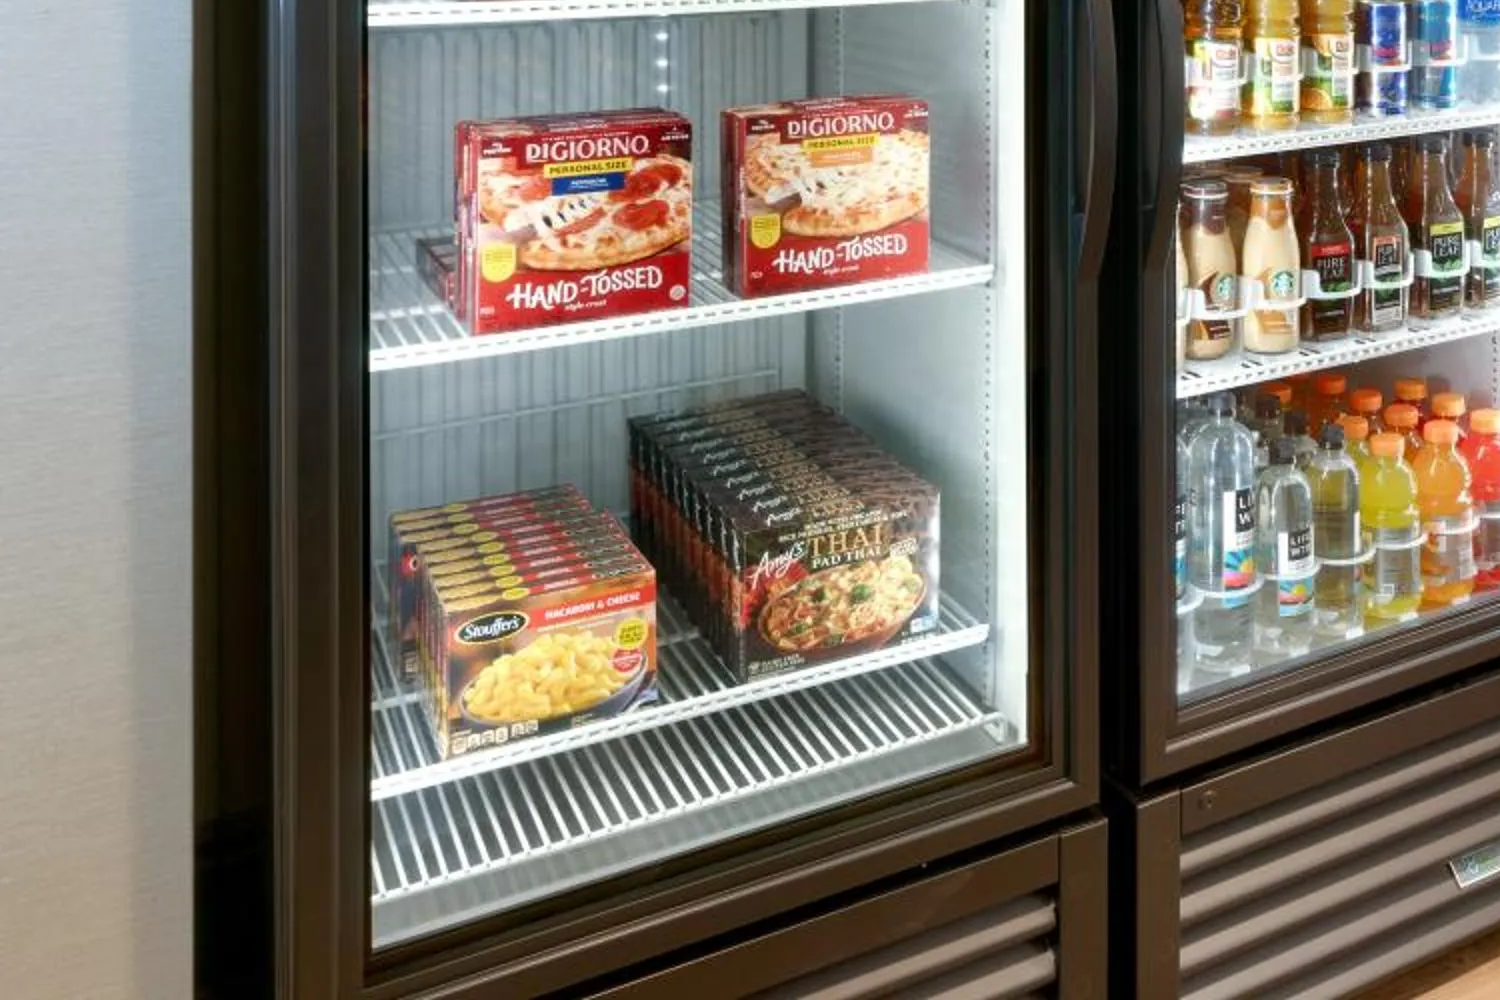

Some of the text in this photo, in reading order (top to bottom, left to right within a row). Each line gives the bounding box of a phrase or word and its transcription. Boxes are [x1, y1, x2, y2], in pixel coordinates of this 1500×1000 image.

[548, 159, 628, 175] PERSONAL SIZE
[505, 264, 663, 312] HAND-TOSSED
[810, 527, 883, 556] THAI
[462, 614, 521, 643] Stouffer's
